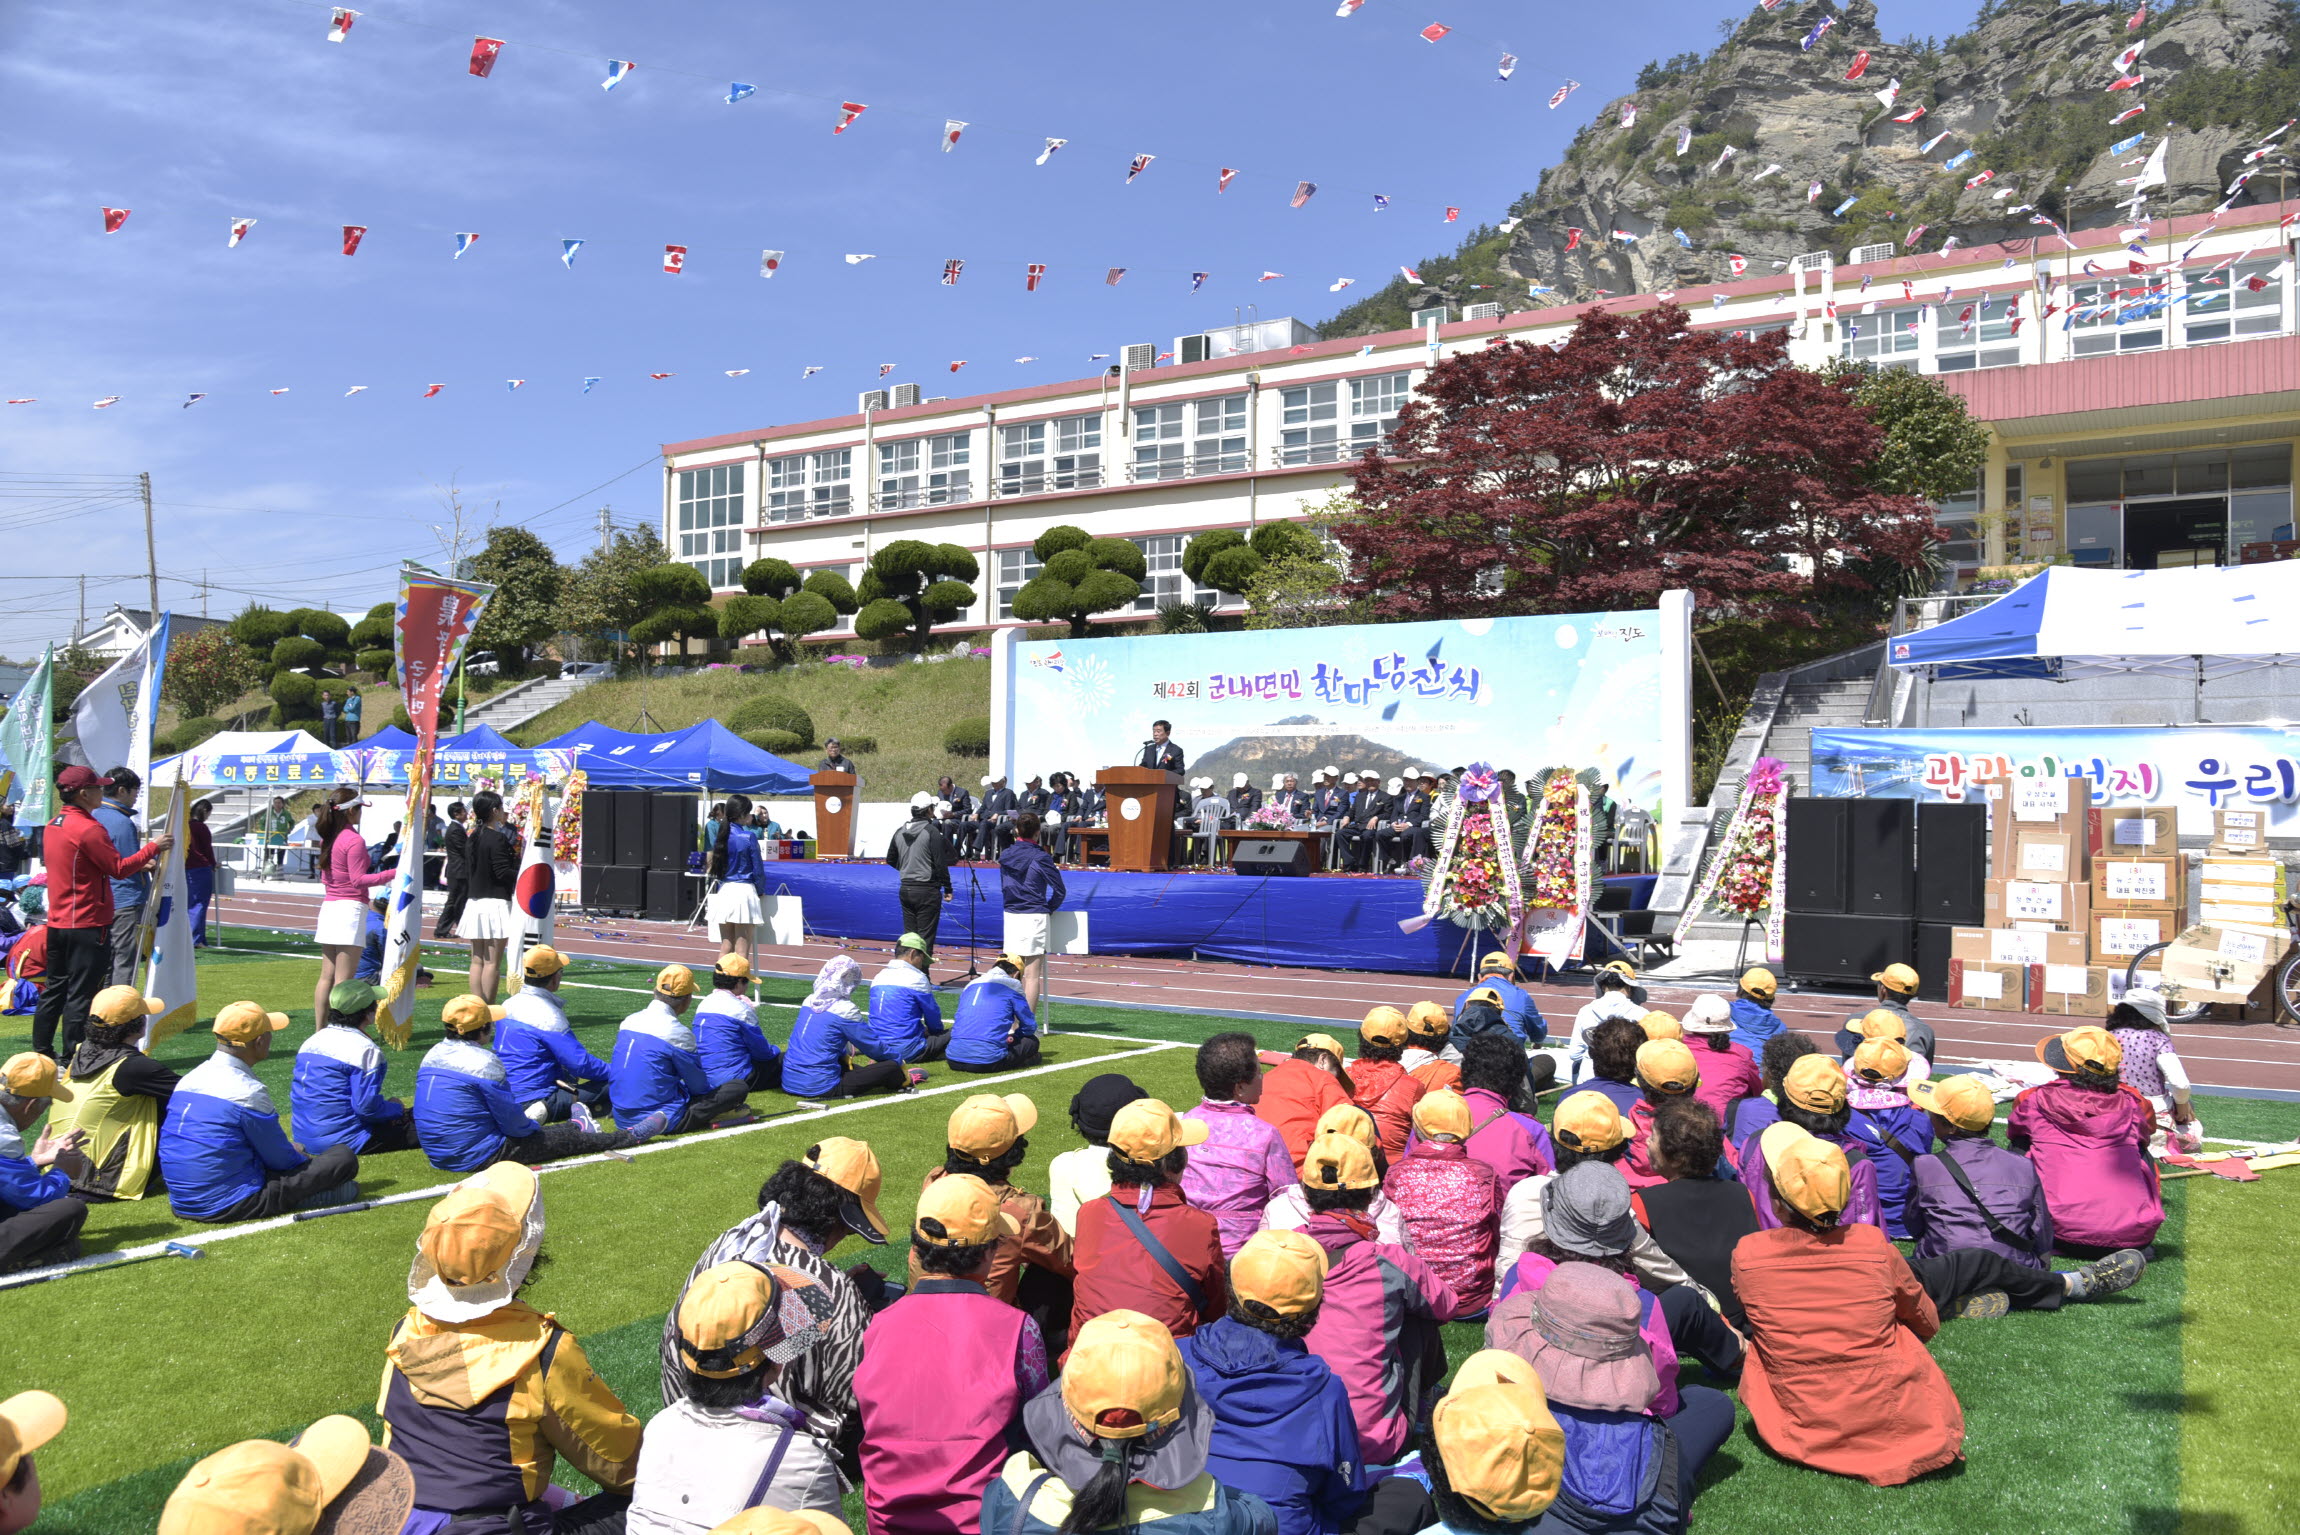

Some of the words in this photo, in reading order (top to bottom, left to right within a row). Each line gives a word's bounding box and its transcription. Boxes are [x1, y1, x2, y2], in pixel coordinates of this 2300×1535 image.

[1619, 626, 1646, 642] 진도
[1153, 680, 1200, 699] 제42회
[1208, 668, 1302, 700] 군내면민
[223, 763, 325, 782] 이동진료소
[2185, 758, 2296, 807] 우리
[2116, 886, 2130, 894] 대표
